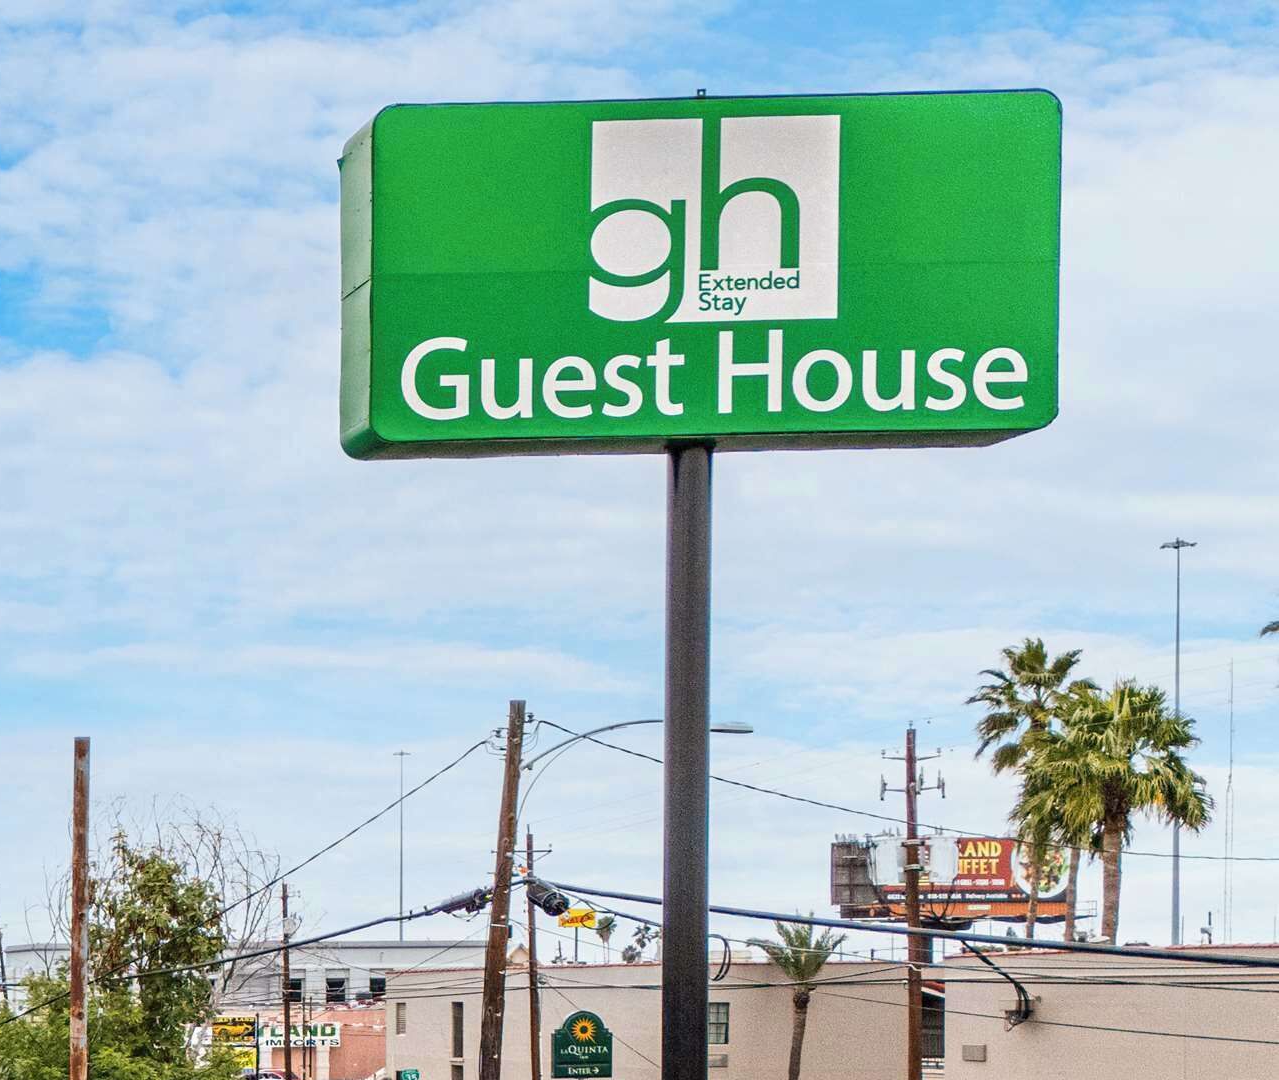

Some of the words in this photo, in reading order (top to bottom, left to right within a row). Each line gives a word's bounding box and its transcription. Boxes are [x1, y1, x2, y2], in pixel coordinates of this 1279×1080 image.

[697, 270, 800, 292] Extended
[697, 291, 747, 316] Stay
[399, 336, 685, 421] Guest
[718, 328, 1029, 415] House
[568, 1044, 609, 1056] QUINTA
